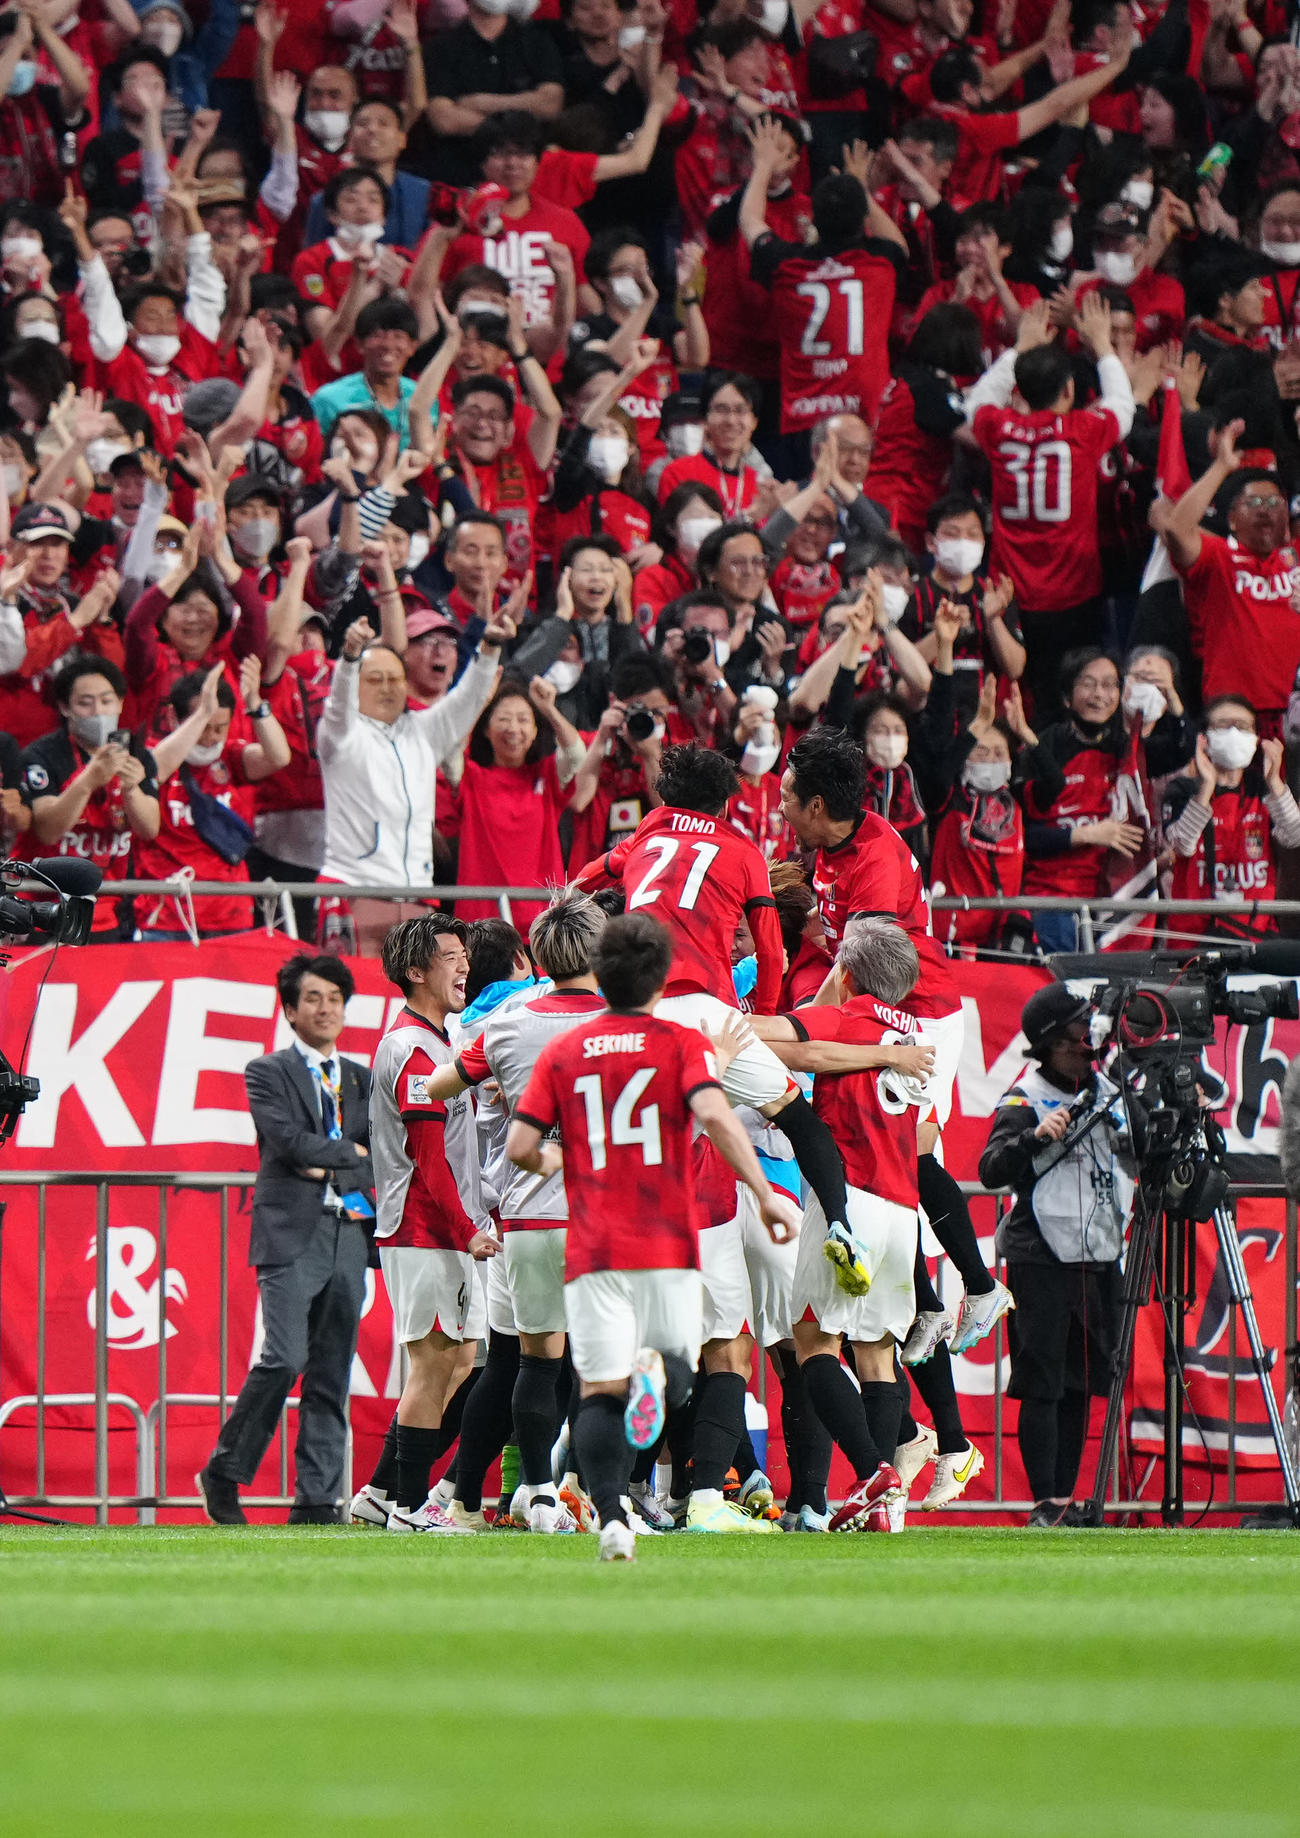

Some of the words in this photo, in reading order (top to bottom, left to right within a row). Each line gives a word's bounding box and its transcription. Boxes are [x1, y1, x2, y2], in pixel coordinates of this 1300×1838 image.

[483, 230, 556, 280] WE
[796, 279, 864, 356] 21
[998, 440, 1073, 522] 30
[671, 813, 716, 835] TOMO
[629, 836, 721, 911] 21
[582, 1032, 647, 1059] SEKINE
[573, 1066, 663, 1172] 14
